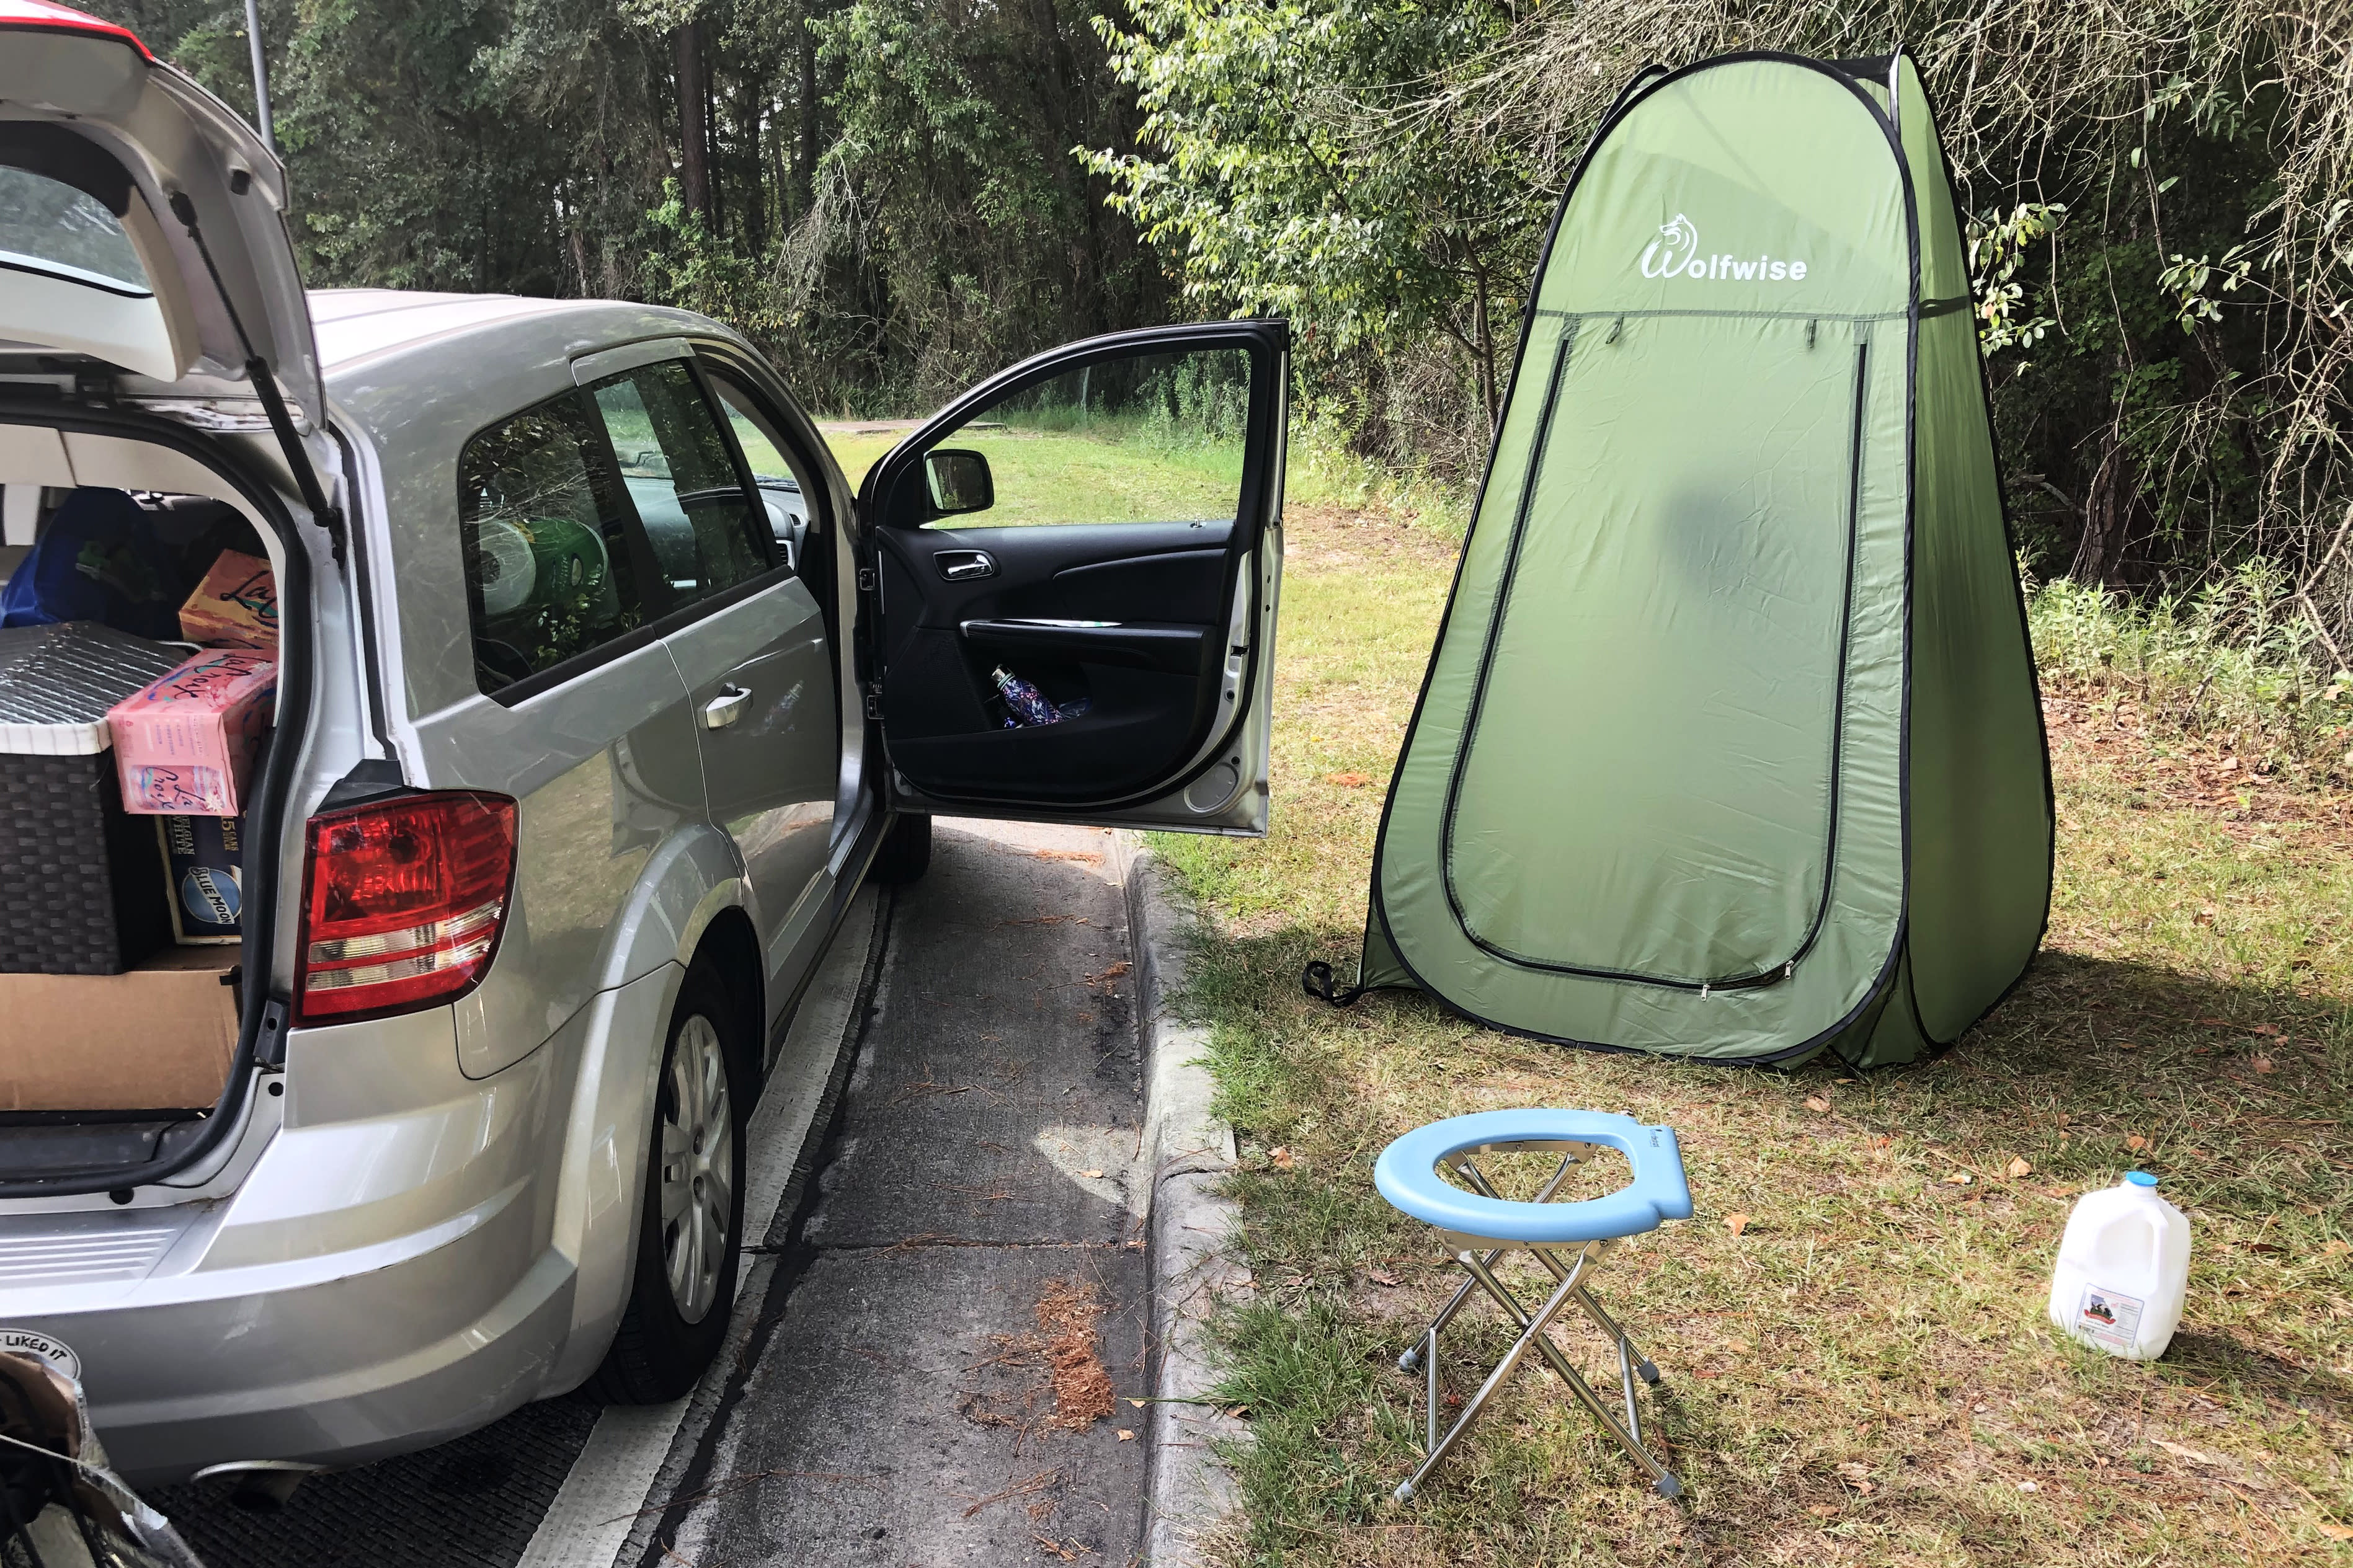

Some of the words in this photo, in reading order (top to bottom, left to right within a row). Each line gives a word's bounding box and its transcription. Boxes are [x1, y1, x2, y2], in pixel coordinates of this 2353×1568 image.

[1641, 213, 1807, 281] Wolfwise
[190, 868, 216, 894] BLUE
[208, 897, 232, 923] MOON
[6, 1335, 49, 1352] LIKED
[49, 1349, 68, 1360] IT
